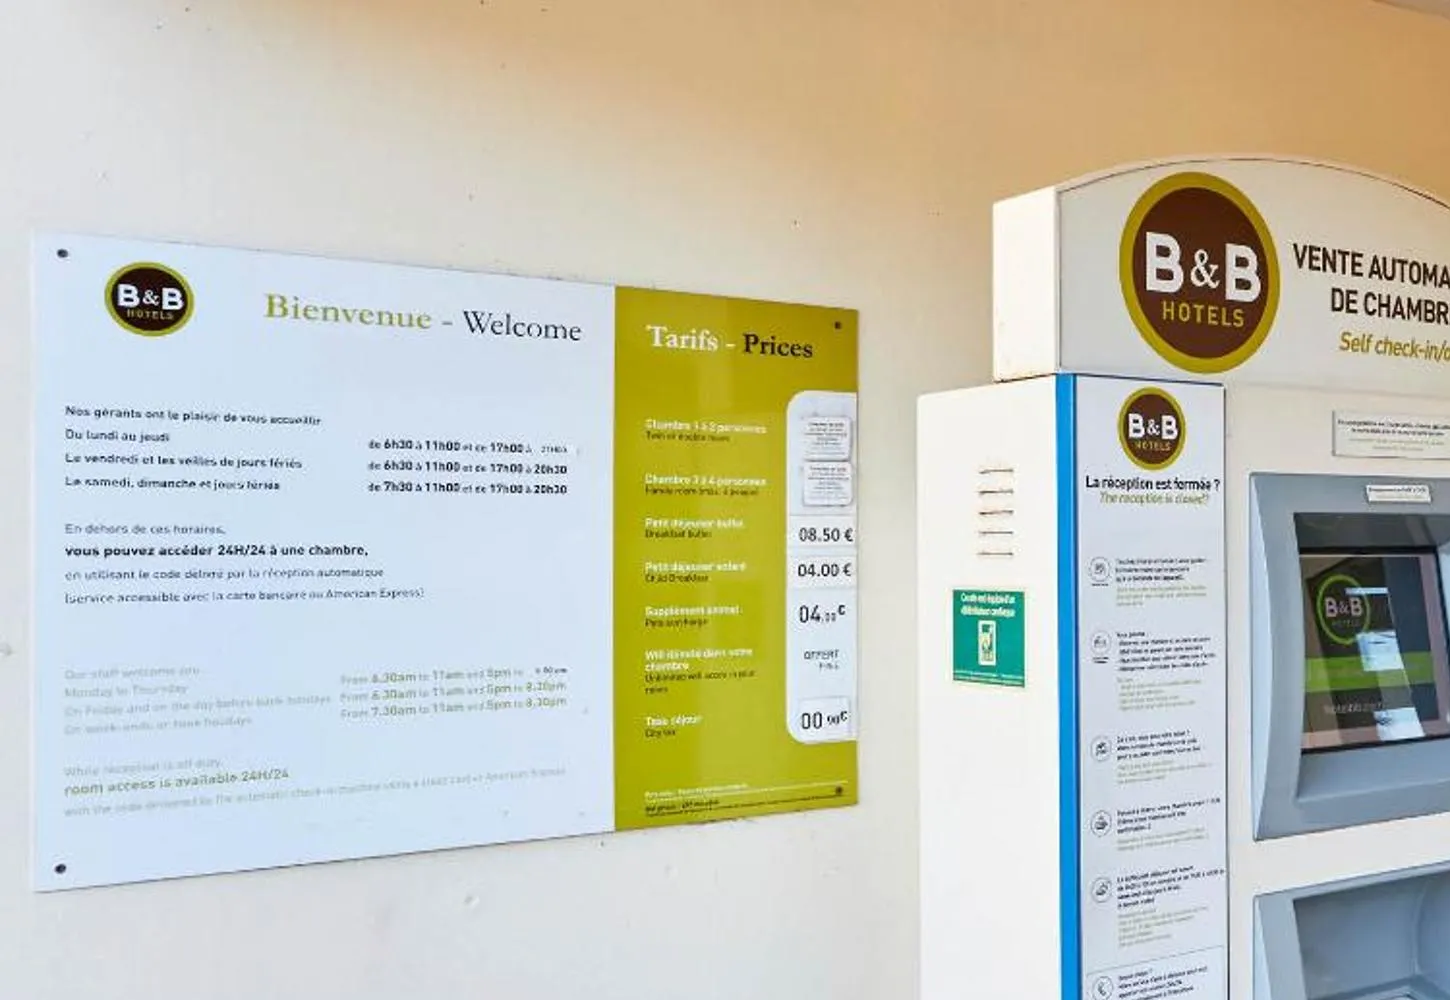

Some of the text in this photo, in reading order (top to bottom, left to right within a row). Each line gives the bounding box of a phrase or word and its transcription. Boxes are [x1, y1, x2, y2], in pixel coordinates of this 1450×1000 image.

[1145, 231, 1262, 304] B&B
[1293, 242, 1364, 278] VENTE
[117, 283, 184, 310] B&B
[1331, 288, 1358, 314] DE
[127, 308, 174, 320] HOTELS
[264, 292, 432, 330] Bienvenue
[463, 309, 582, 342] Welcome
[1161, 300, 1244, 328] HOTELS
[646, 325, 718, 351] Tarifs
[743, 333, 813, 358] Prices
[1339, 331, 1374, 356] Self
[65, 406, 90, 417] Nos
[147, 411, 164, 420] ont
[168, 410, 179, 420] le
[224, 413, 238, 422] de
[1128, 413, 1178, 440] B&B
[65, 429, 169, 444] Du lundi au jeudi
[425, 440, 460, 451] 11h00
[1134, 440, 1171, 451] HOTELS
[65, 453, 81, 463] Le
[84, 453, 139, 465] vendredi
[143, 455, 155, 465] et
[220, 456, 233, 467] de
[236, 457, 267, 469] jours
[425, 461, 460, 472] 11h00
[65, 476, 81, 487] Le
[137, 478, 196, 489] dimanche
[199, 479, 211, 489] et
[384, 481, 413, 492] 7h30
[425, 482, 460, 493] 11h00
[1086, 476, 1098, 488] La
[1156, 479, 1170, 489] est
[65, 524, 82, 535] En
[85, 523, 129, 535] dehors
[133, 524, 147, 535] de
[799, 527, 854, 542] 08.50 €
[65, 544, 369, 560] vous pouvez accéder 24H/24 à une chambre,
[84, 568, 135, 581] utilisant
[153, 568, 181, 579] code
[798, 563, 852, 577] 04.00 €
[1325, 596, 1363, 617] B&B
[64, 783, 104, 796] room
[107, 780, 155, 792] access
